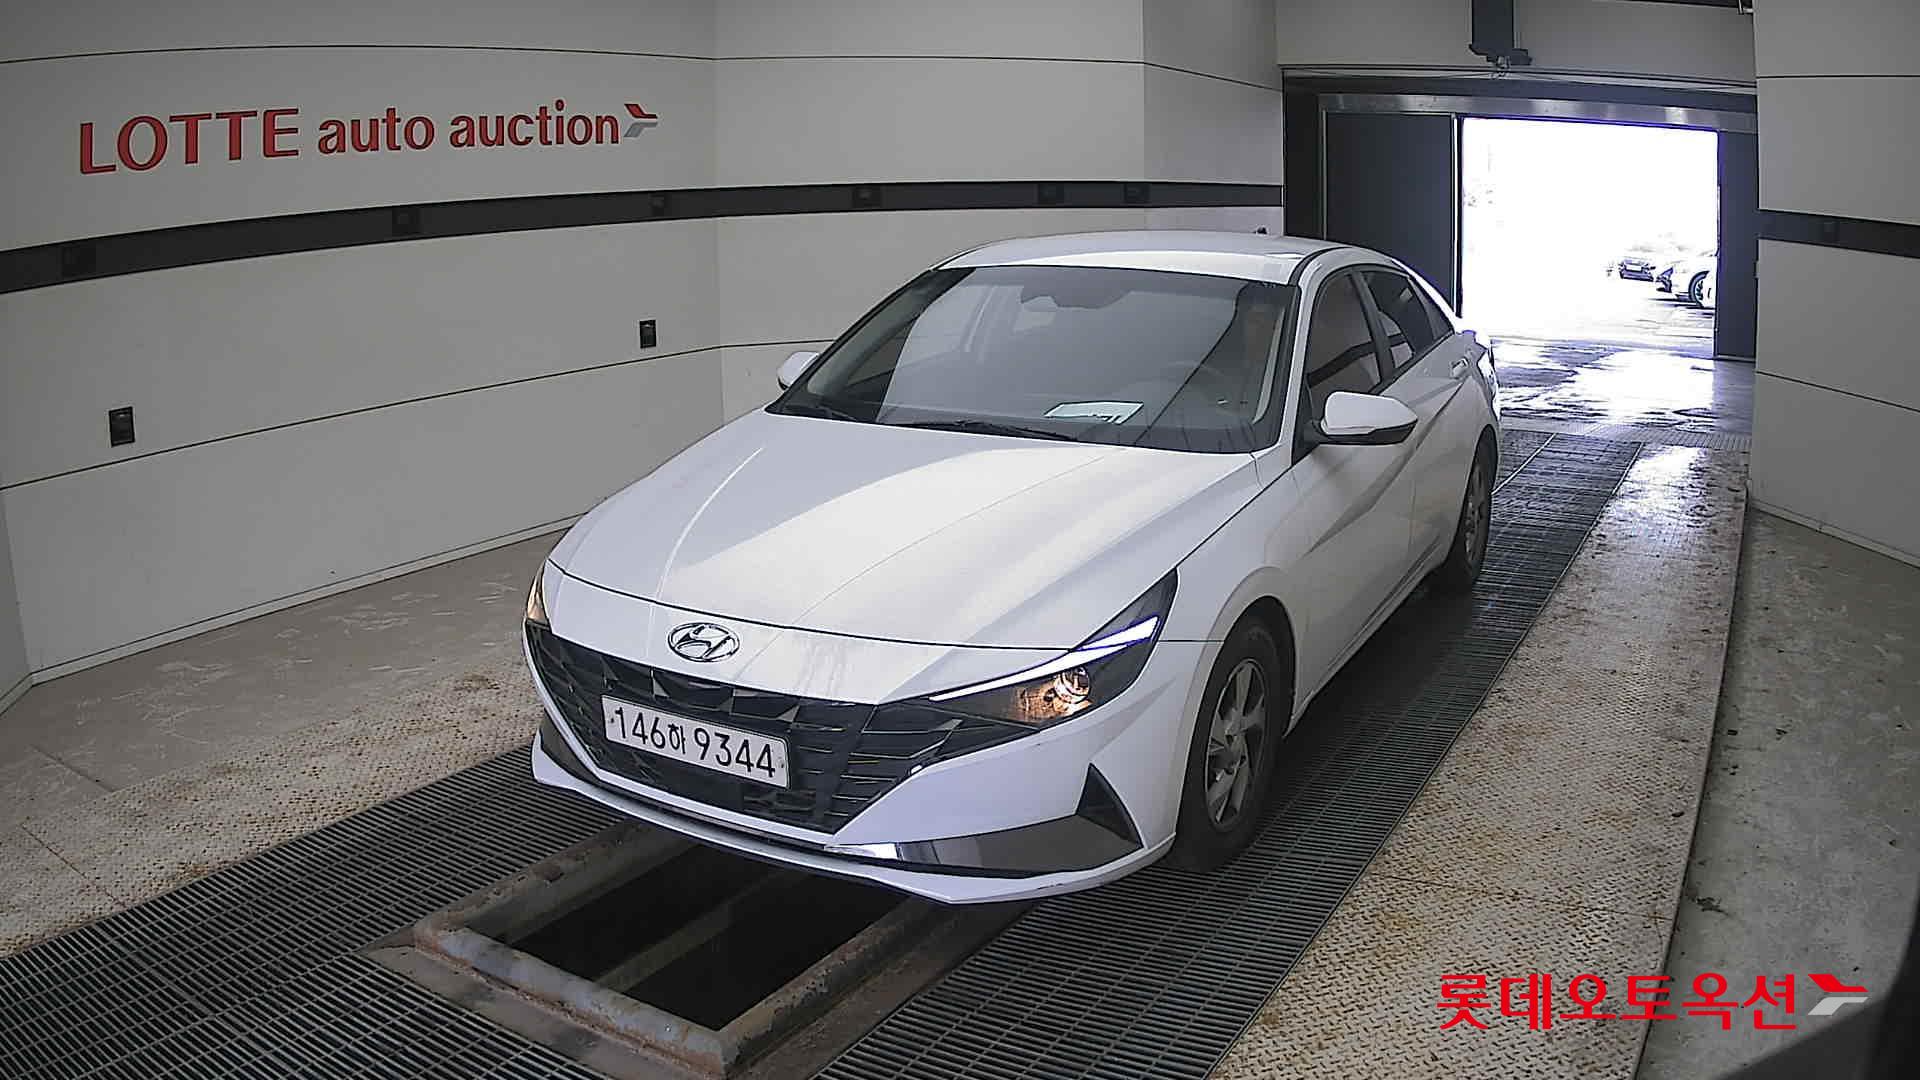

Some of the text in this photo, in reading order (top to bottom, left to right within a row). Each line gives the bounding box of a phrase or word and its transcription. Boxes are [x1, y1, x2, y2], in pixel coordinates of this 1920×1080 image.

[80, 99, 620, 174] LOTTE auto auction
[615, 706, 776, 778] 146하 9344
